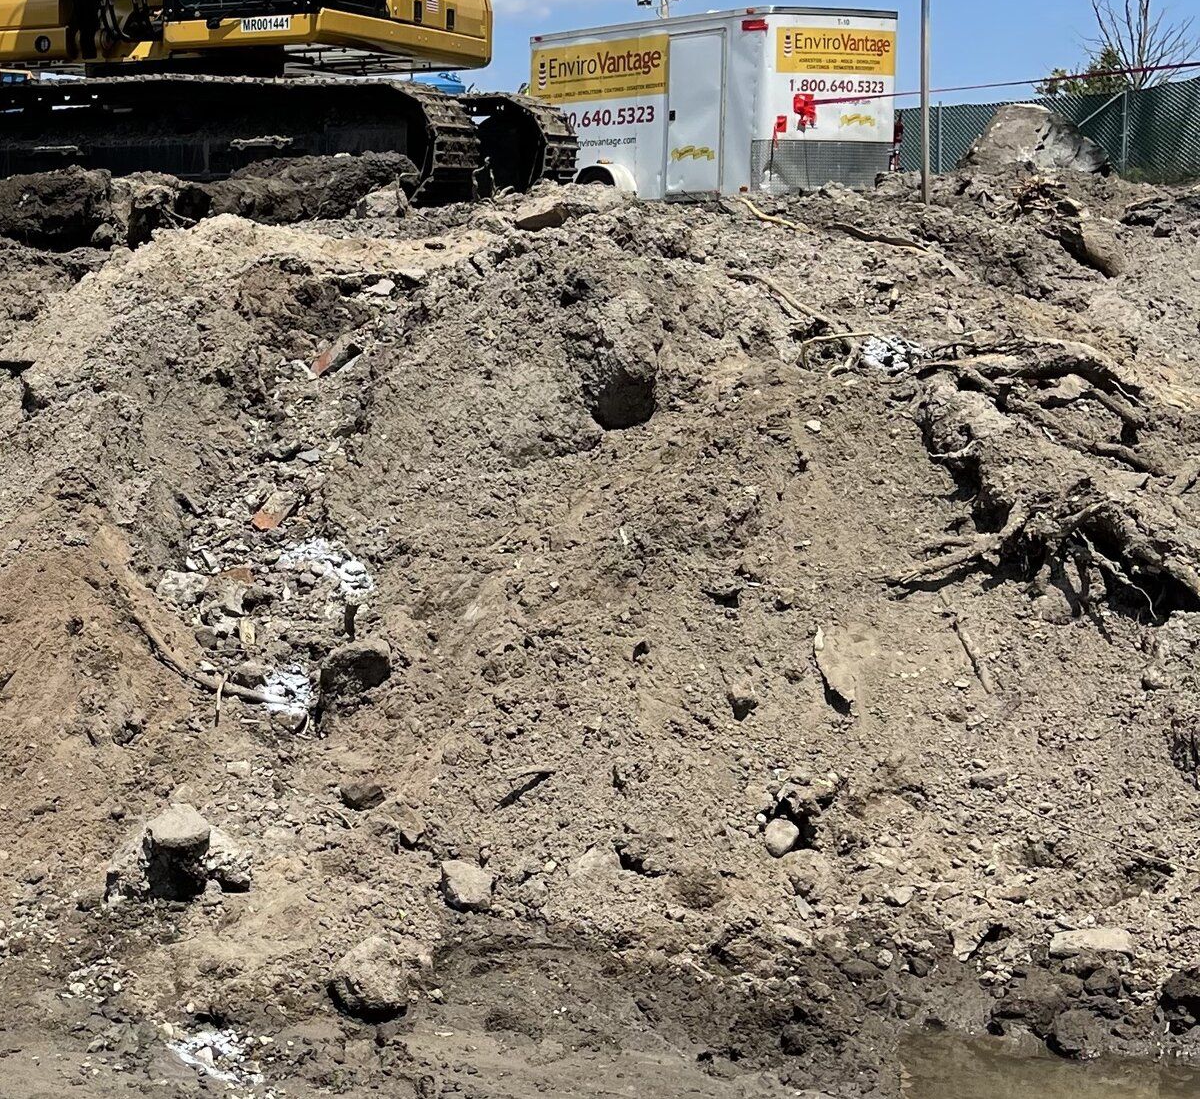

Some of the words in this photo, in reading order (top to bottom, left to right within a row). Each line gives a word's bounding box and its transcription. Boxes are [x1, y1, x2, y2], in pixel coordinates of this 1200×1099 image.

[242, 17, 289, 31] MR001441
[794, 32, 891, 57] EnviroVantage
[549, 50, 662, 79] EnviroVantage
[790, 79, 884, 93] 1.800.640.5323
[568, 105, 655, 128] 0.640.5323
[579, 137, 637, 148] nvirovantage.com
